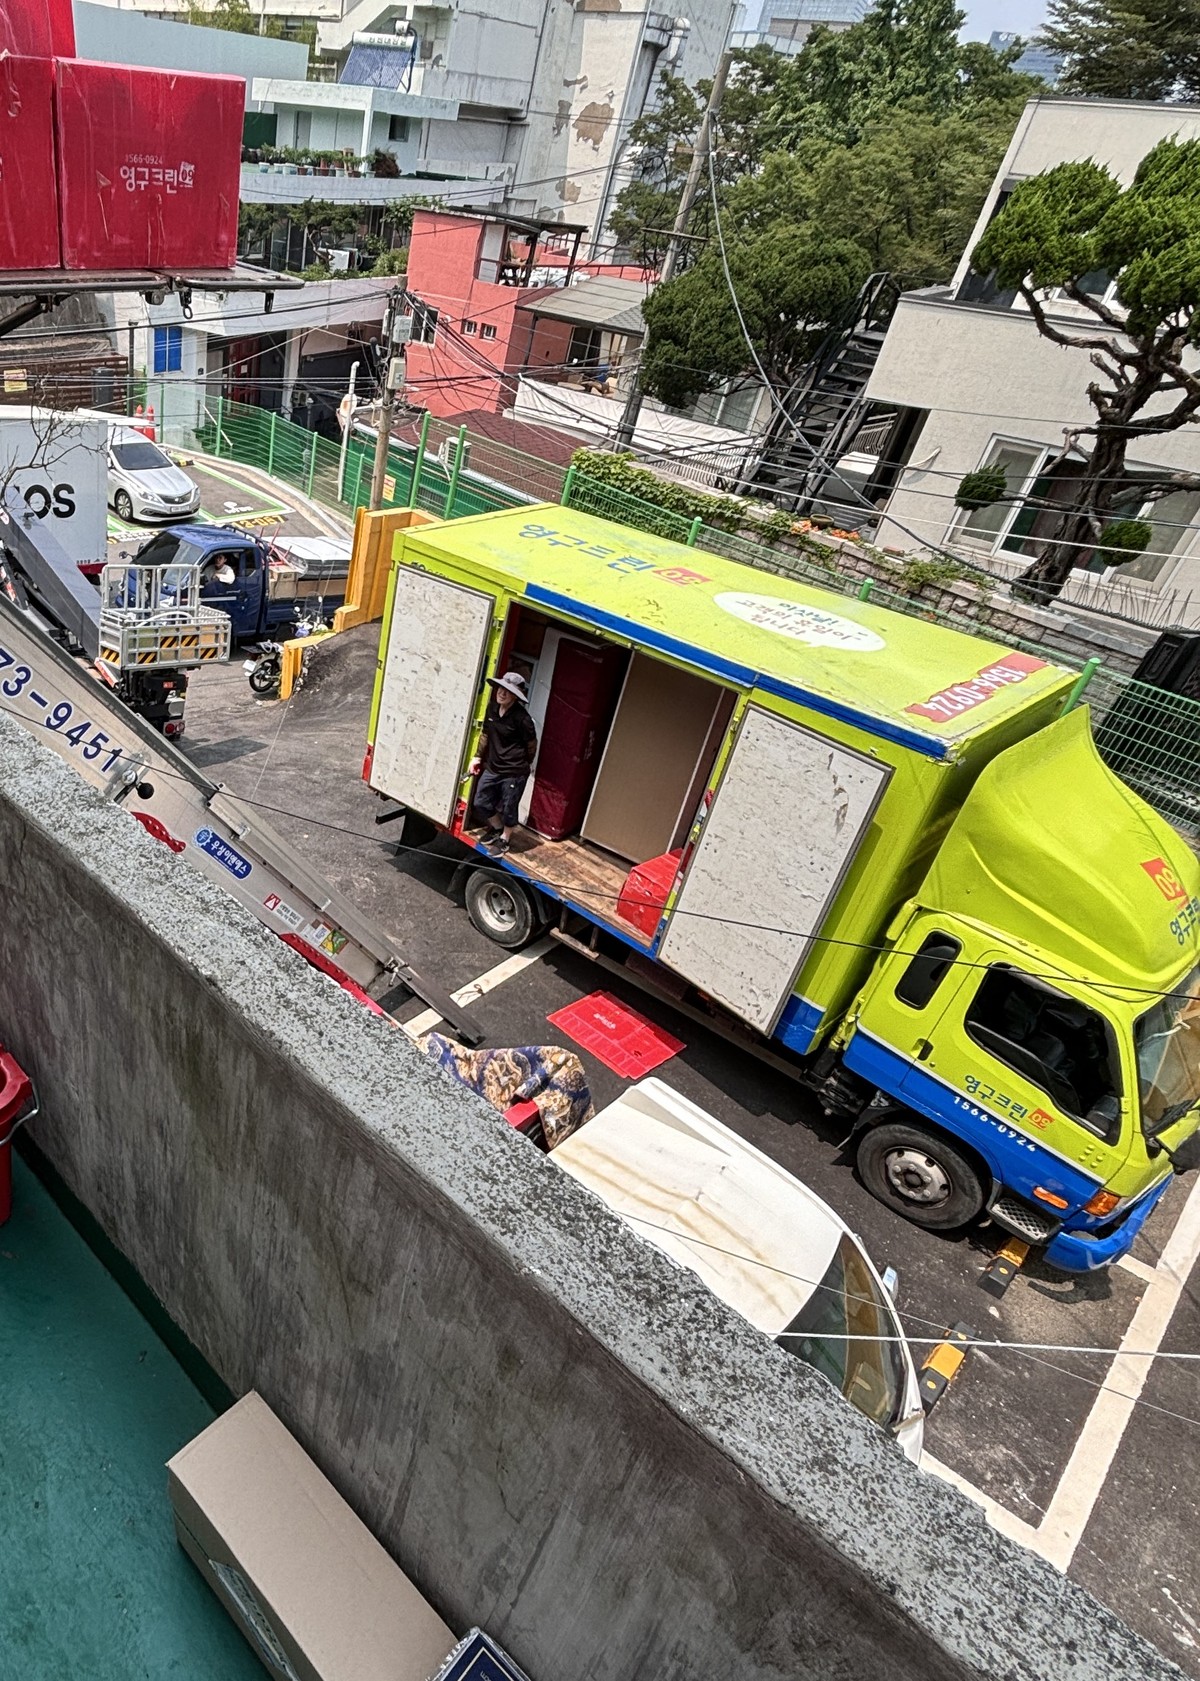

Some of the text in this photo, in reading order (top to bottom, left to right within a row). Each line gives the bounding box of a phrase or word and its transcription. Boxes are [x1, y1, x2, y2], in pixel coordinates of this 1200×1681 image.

[120, 165, 178, 194] 영구크린
[125, 153, 163, 165] 1566-0924
[14, 483, 76, 519] OS
[518, 524, 656, 574] 영구크린
[920, 665, 1028, 717] 1566-0924
[964, 1075, 1028, 1122] 영구크린
